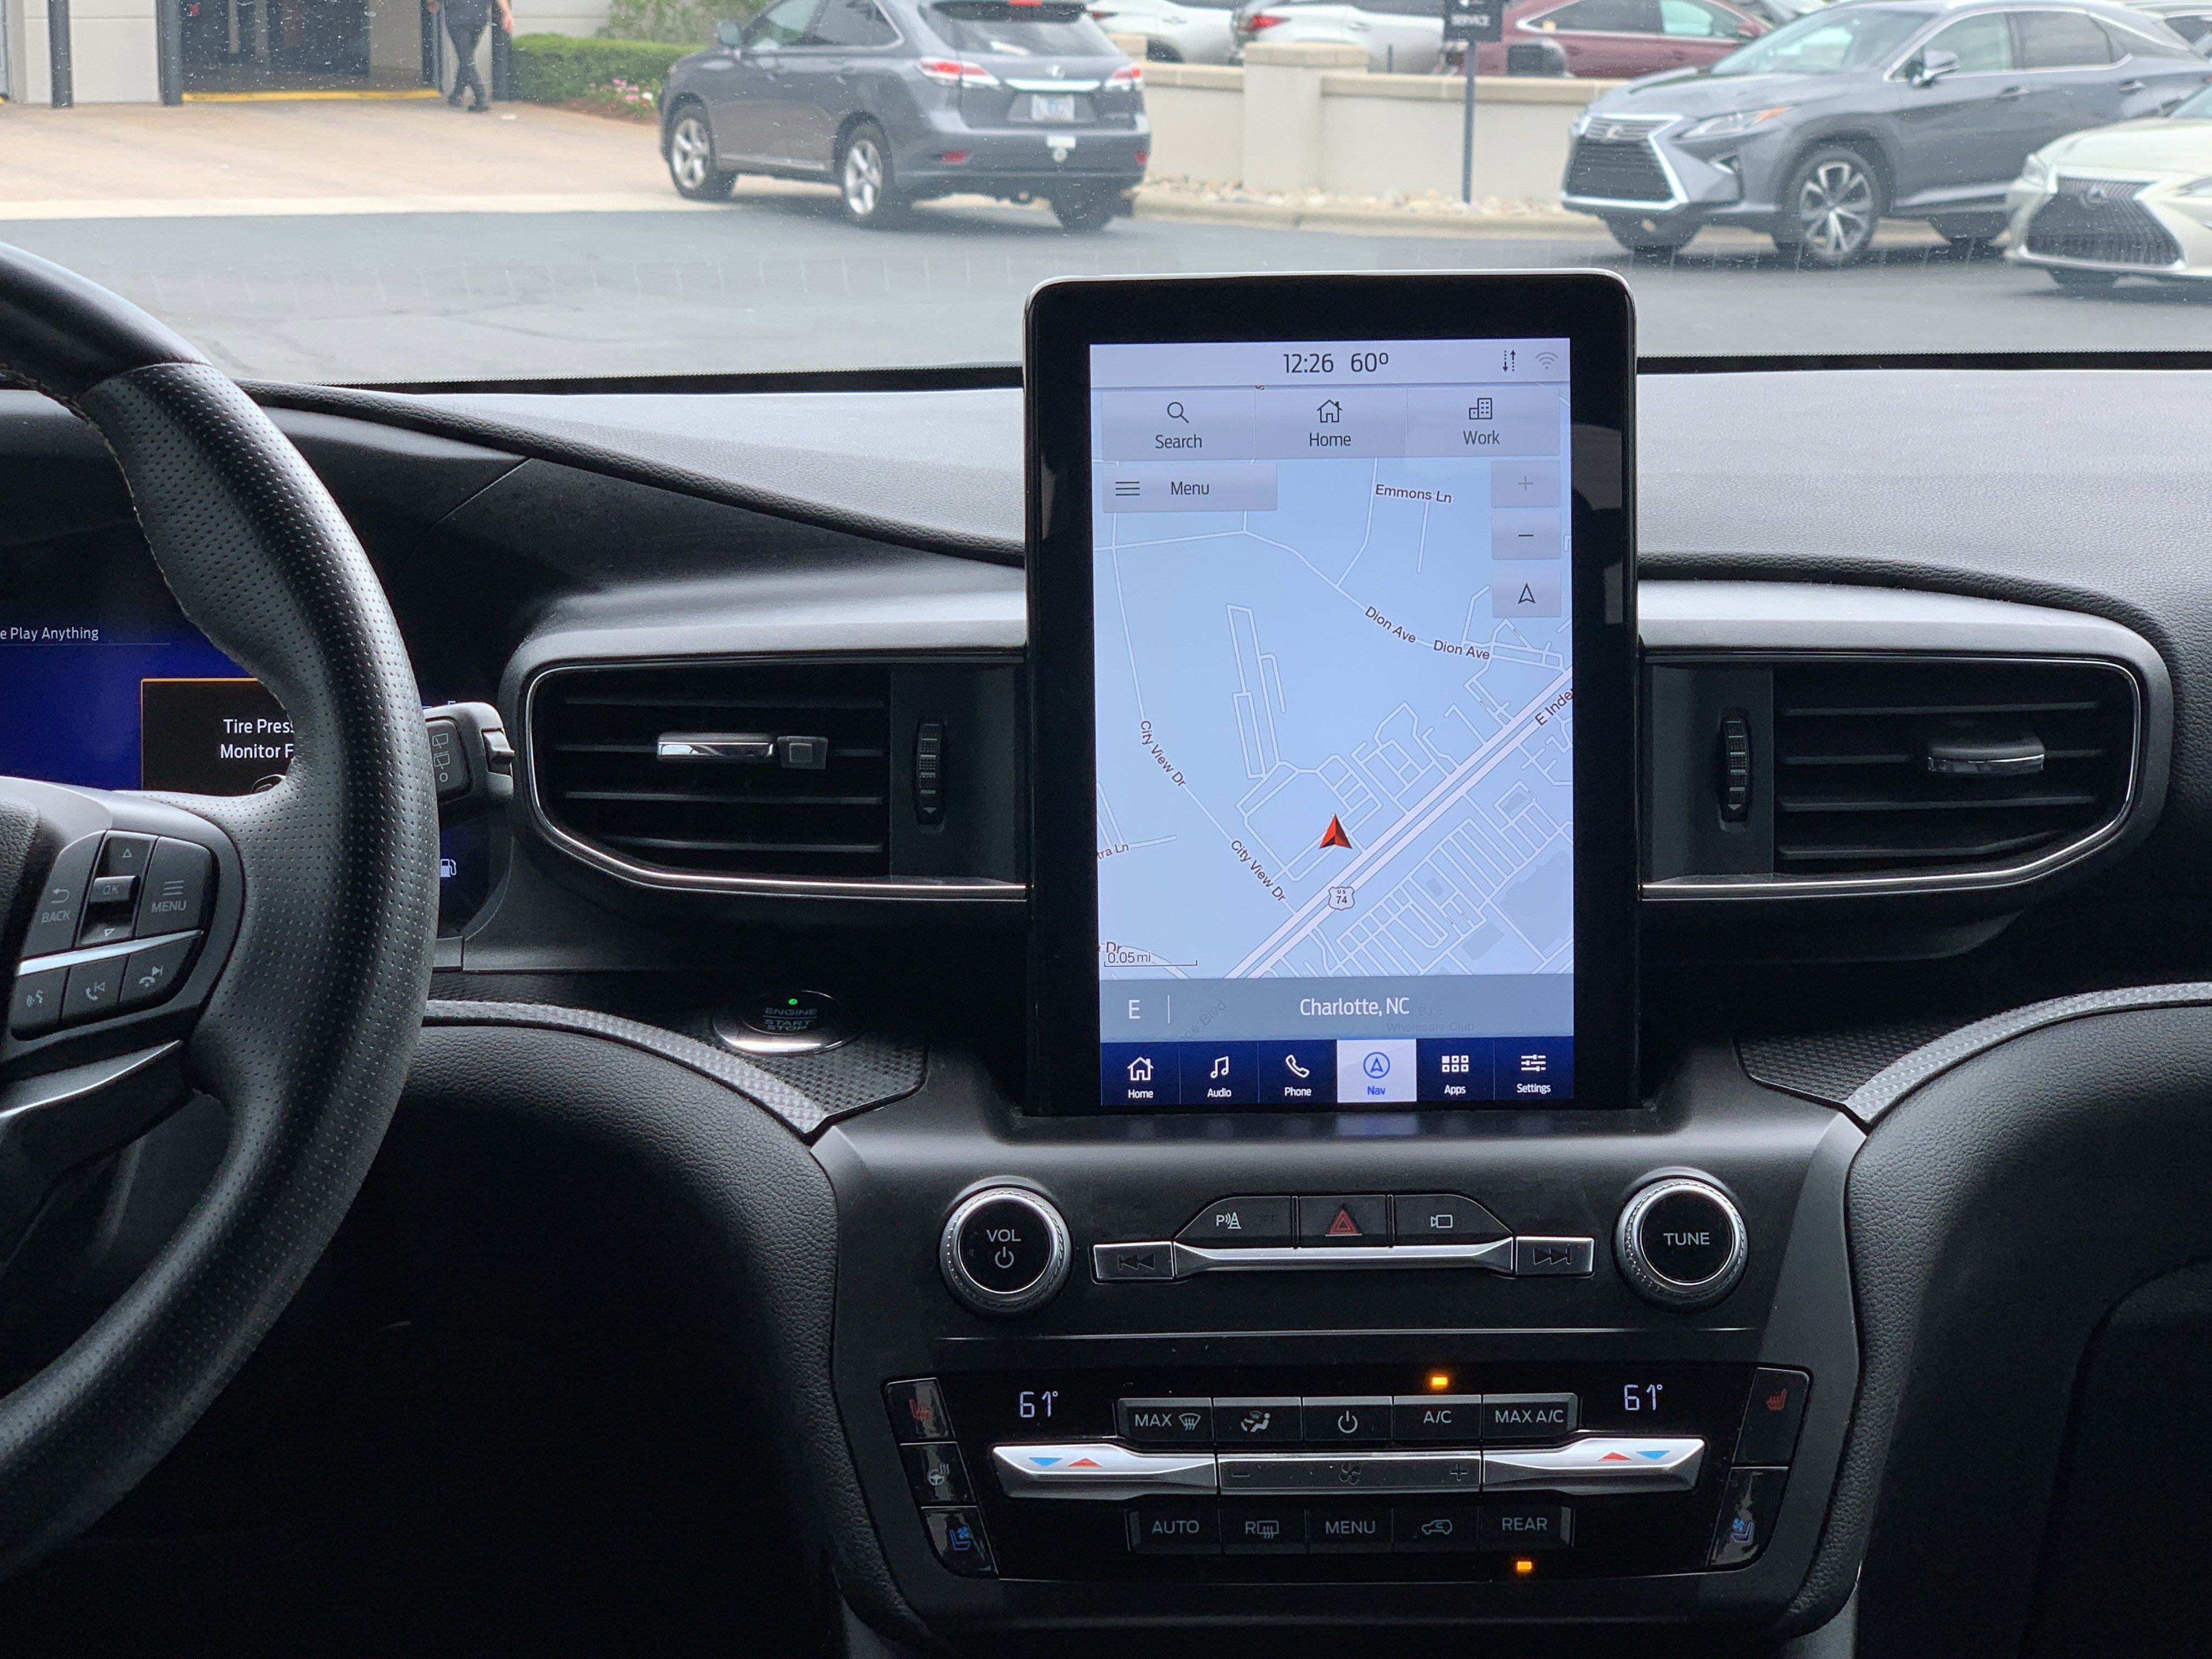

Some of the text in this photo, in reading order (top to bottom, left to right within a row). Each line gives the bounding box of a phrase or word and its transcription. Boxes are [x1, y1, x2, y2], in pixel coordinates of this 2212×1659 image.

[1283, 353, 1335, 375] 12:26
[1155, 434, 1203, 451] Search
[1308, 432, 1352, 448] Home
[1463, 430, 1501, 446] Work
[1170, 481, 1210, 496] Menu
[1375, 484, 1453, 504] Emmons Ln
[1365, 606, 1417, 644] Dion Ave
[10, 627, 38, 642] Play
[42, 627, 99, 642] Anything
[1434, 640, 1491, 660] Dion Ave
[1534, 688, 1572, 726] E Inde
[223, 719, 252, 733] Tire
[221, 743, 280, 759] Monitor
[1141, 721, 1187, 787] City View Dr
[1115, 843, 1130, 853] Ln
[1231, 840, 1286, 902] City View Dr
[103, 884, 119, 895] OK
[151, 899, 187, 913] MENU
[1336, 895, 1347, 905] 74
[42, 909, 72, 923] BACK
[1106, 941, 1122, 953] Dr
[1108, 951, 1151, 963] 0.05 mi
[1128, 1000, 1140, 1019] E
[1300, 997, 1410, 1018] Charlotte, NC
[1128, 1089, 1153, 1099] Home
[1207, 1088, 1232, 1098] Audio
[1285, 1086, 1312, 1097] Phone
[1368, 1085, 1386, 1096] Nav
[1444, 1084, 1466, 1096] Apps
[1517, 1083, 1551, 1096] Settings
[987, 1229, 1021, 1242] VOL
[1664, 1233, 1710, 1245] TUNE
[1135, 1414, 1172, 1427] MAX
[1423, 1410, 1452, 1424] A/C
[1494, 1409, 1565, 1424] MAX A/C
[1152, 1521, 1200, 1534] AUTO
[1325, 1521, 1376, 1534] MENU
[1502, 1517, 1548, 1531] REAR
